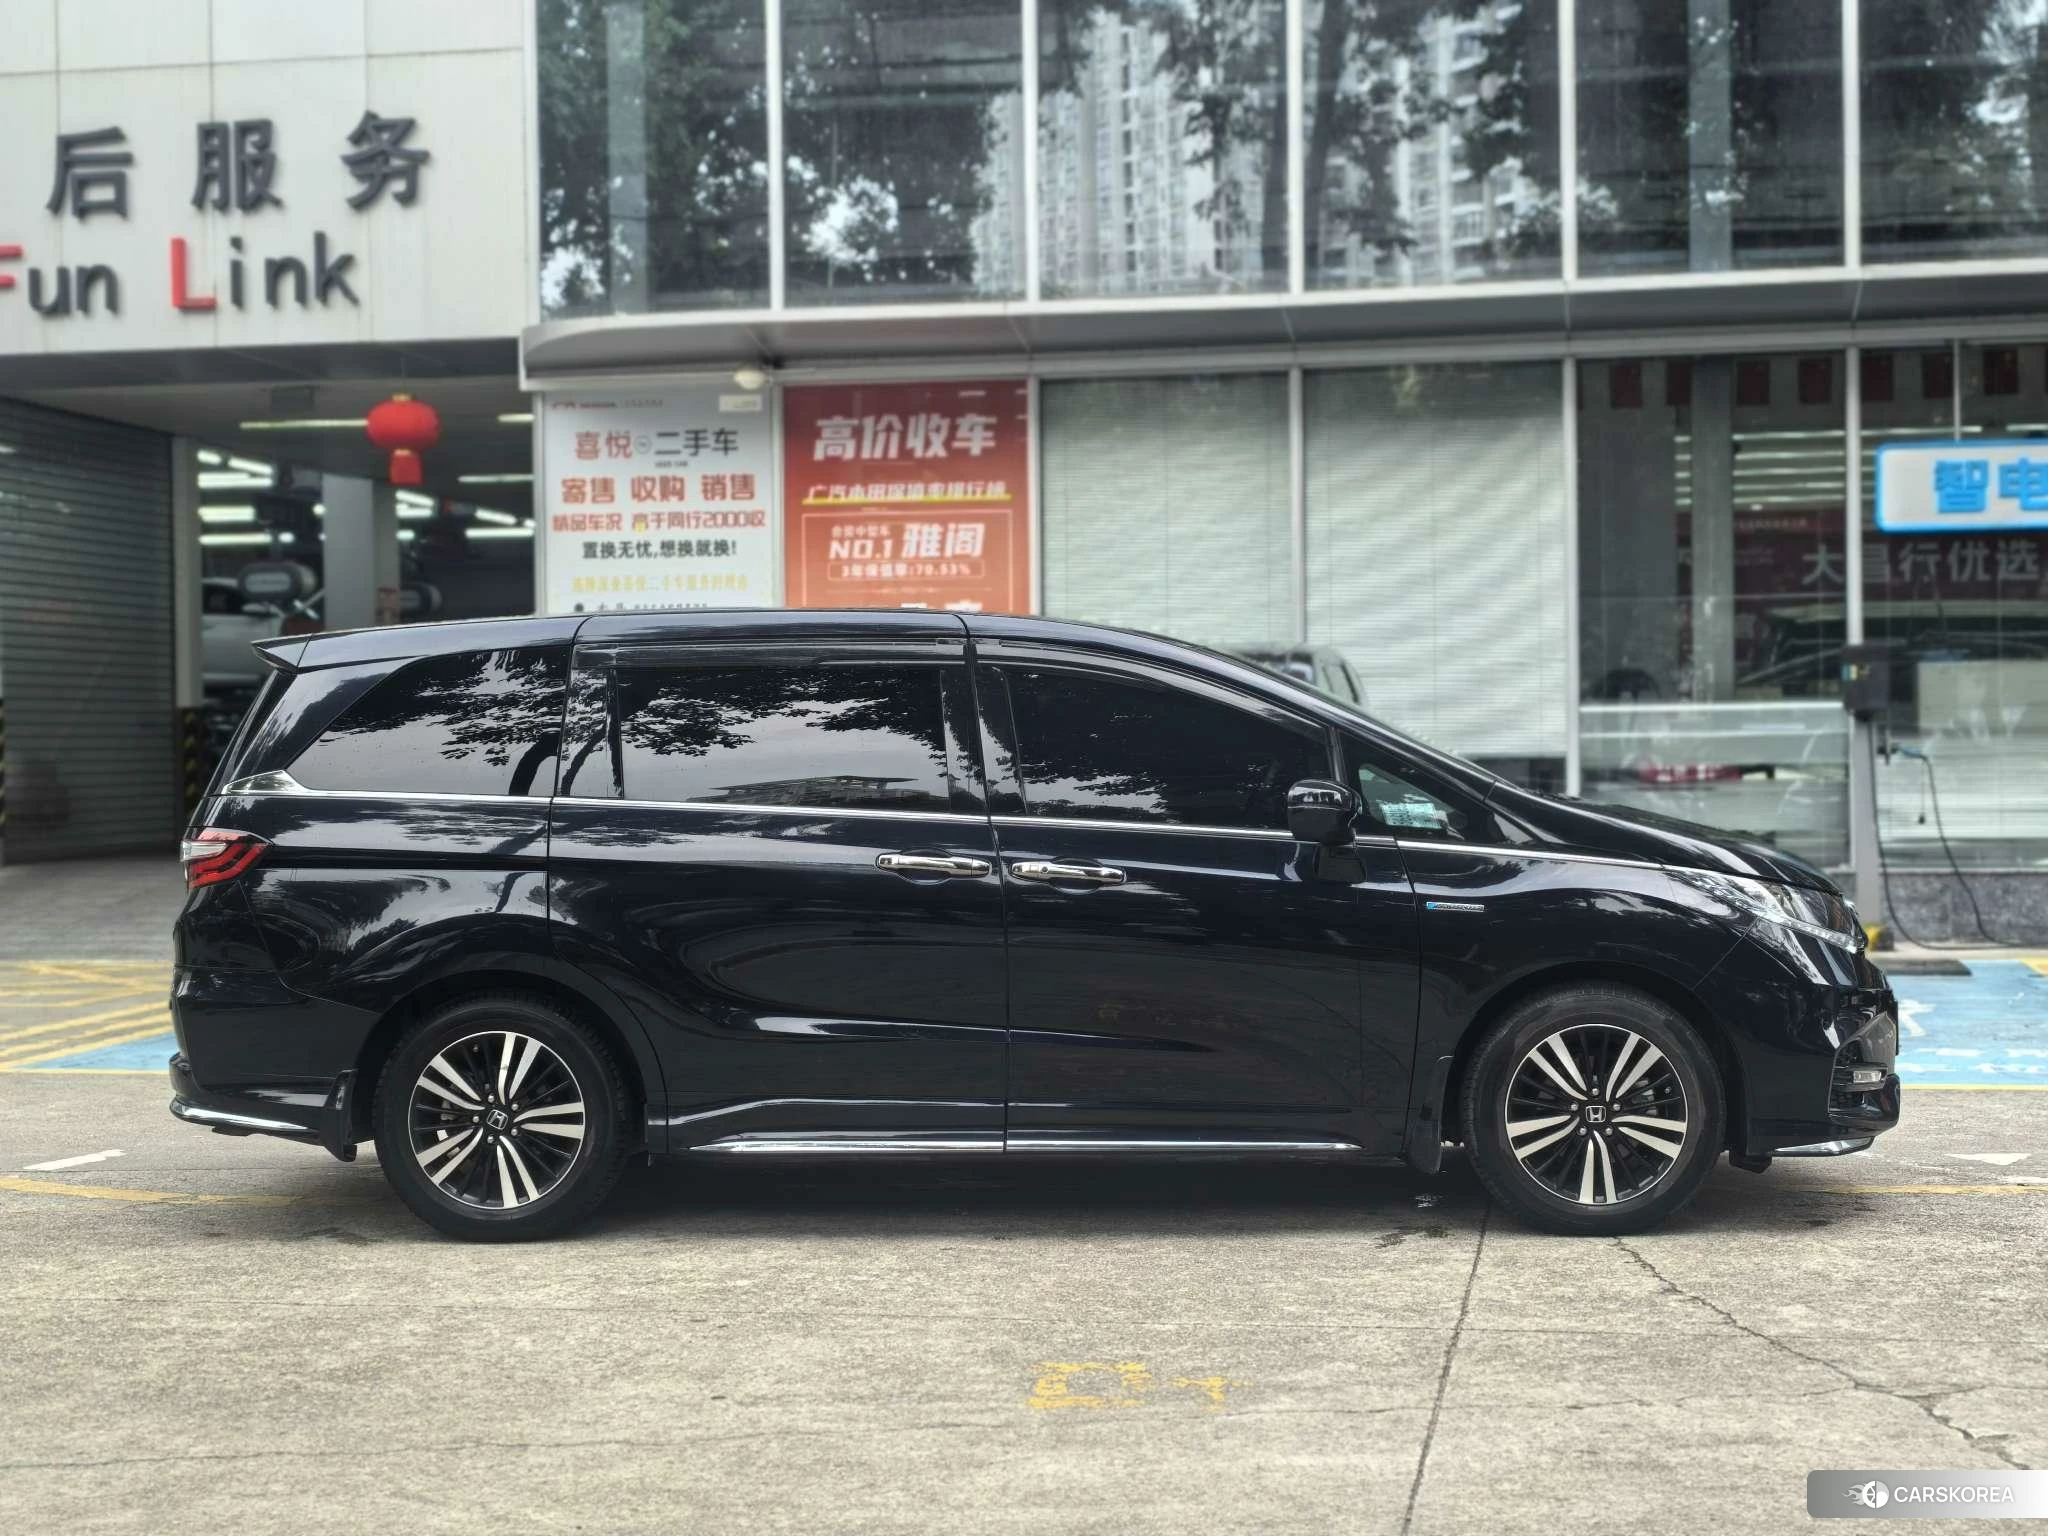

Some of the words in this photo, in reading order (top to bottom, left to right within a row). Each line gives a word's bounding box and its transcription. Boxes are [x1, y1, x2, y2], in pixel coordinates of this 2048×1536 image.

[46, 110, 430, 219] 后服务
[171, 230, 360, 312] Link
[575, 430, 632, 460] 喜悦
[654, 428, 739, 456] 二手车
[813, 412, 998, 461] 高价收车
[561, 477, 615, 504] 寄售
[630, 474, 686, 502] 收购
[701, 473, 755, 501] 销售
[1934, 457, 2048, 514] 智电
[829, 539, 893, 560] NO.1
[901, 522, 986, 558] 雅阁
